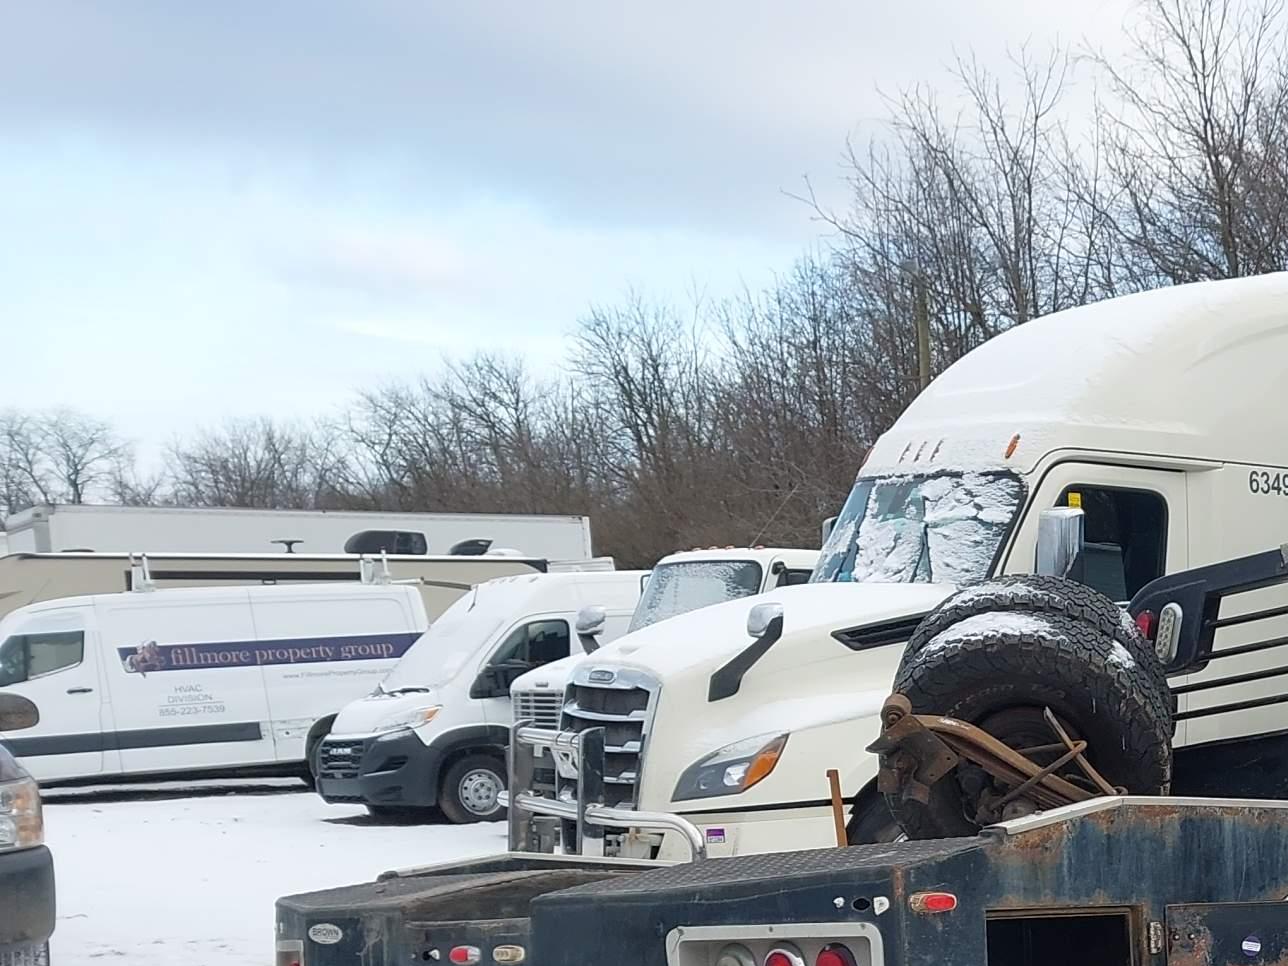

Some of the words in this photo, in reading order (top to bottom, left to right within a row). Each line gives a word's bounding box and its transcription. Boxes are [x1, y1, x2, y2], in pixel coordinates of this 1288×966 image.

[170, 647, 250, 666] fillmore
[255, 644, 335, 664] property
[340, 641, 394, 659] group
[174, 683, 203, 694] HVAC
[166, 693, 213, 704] DIVISION
[311, 927, 340, 937] BROWN
